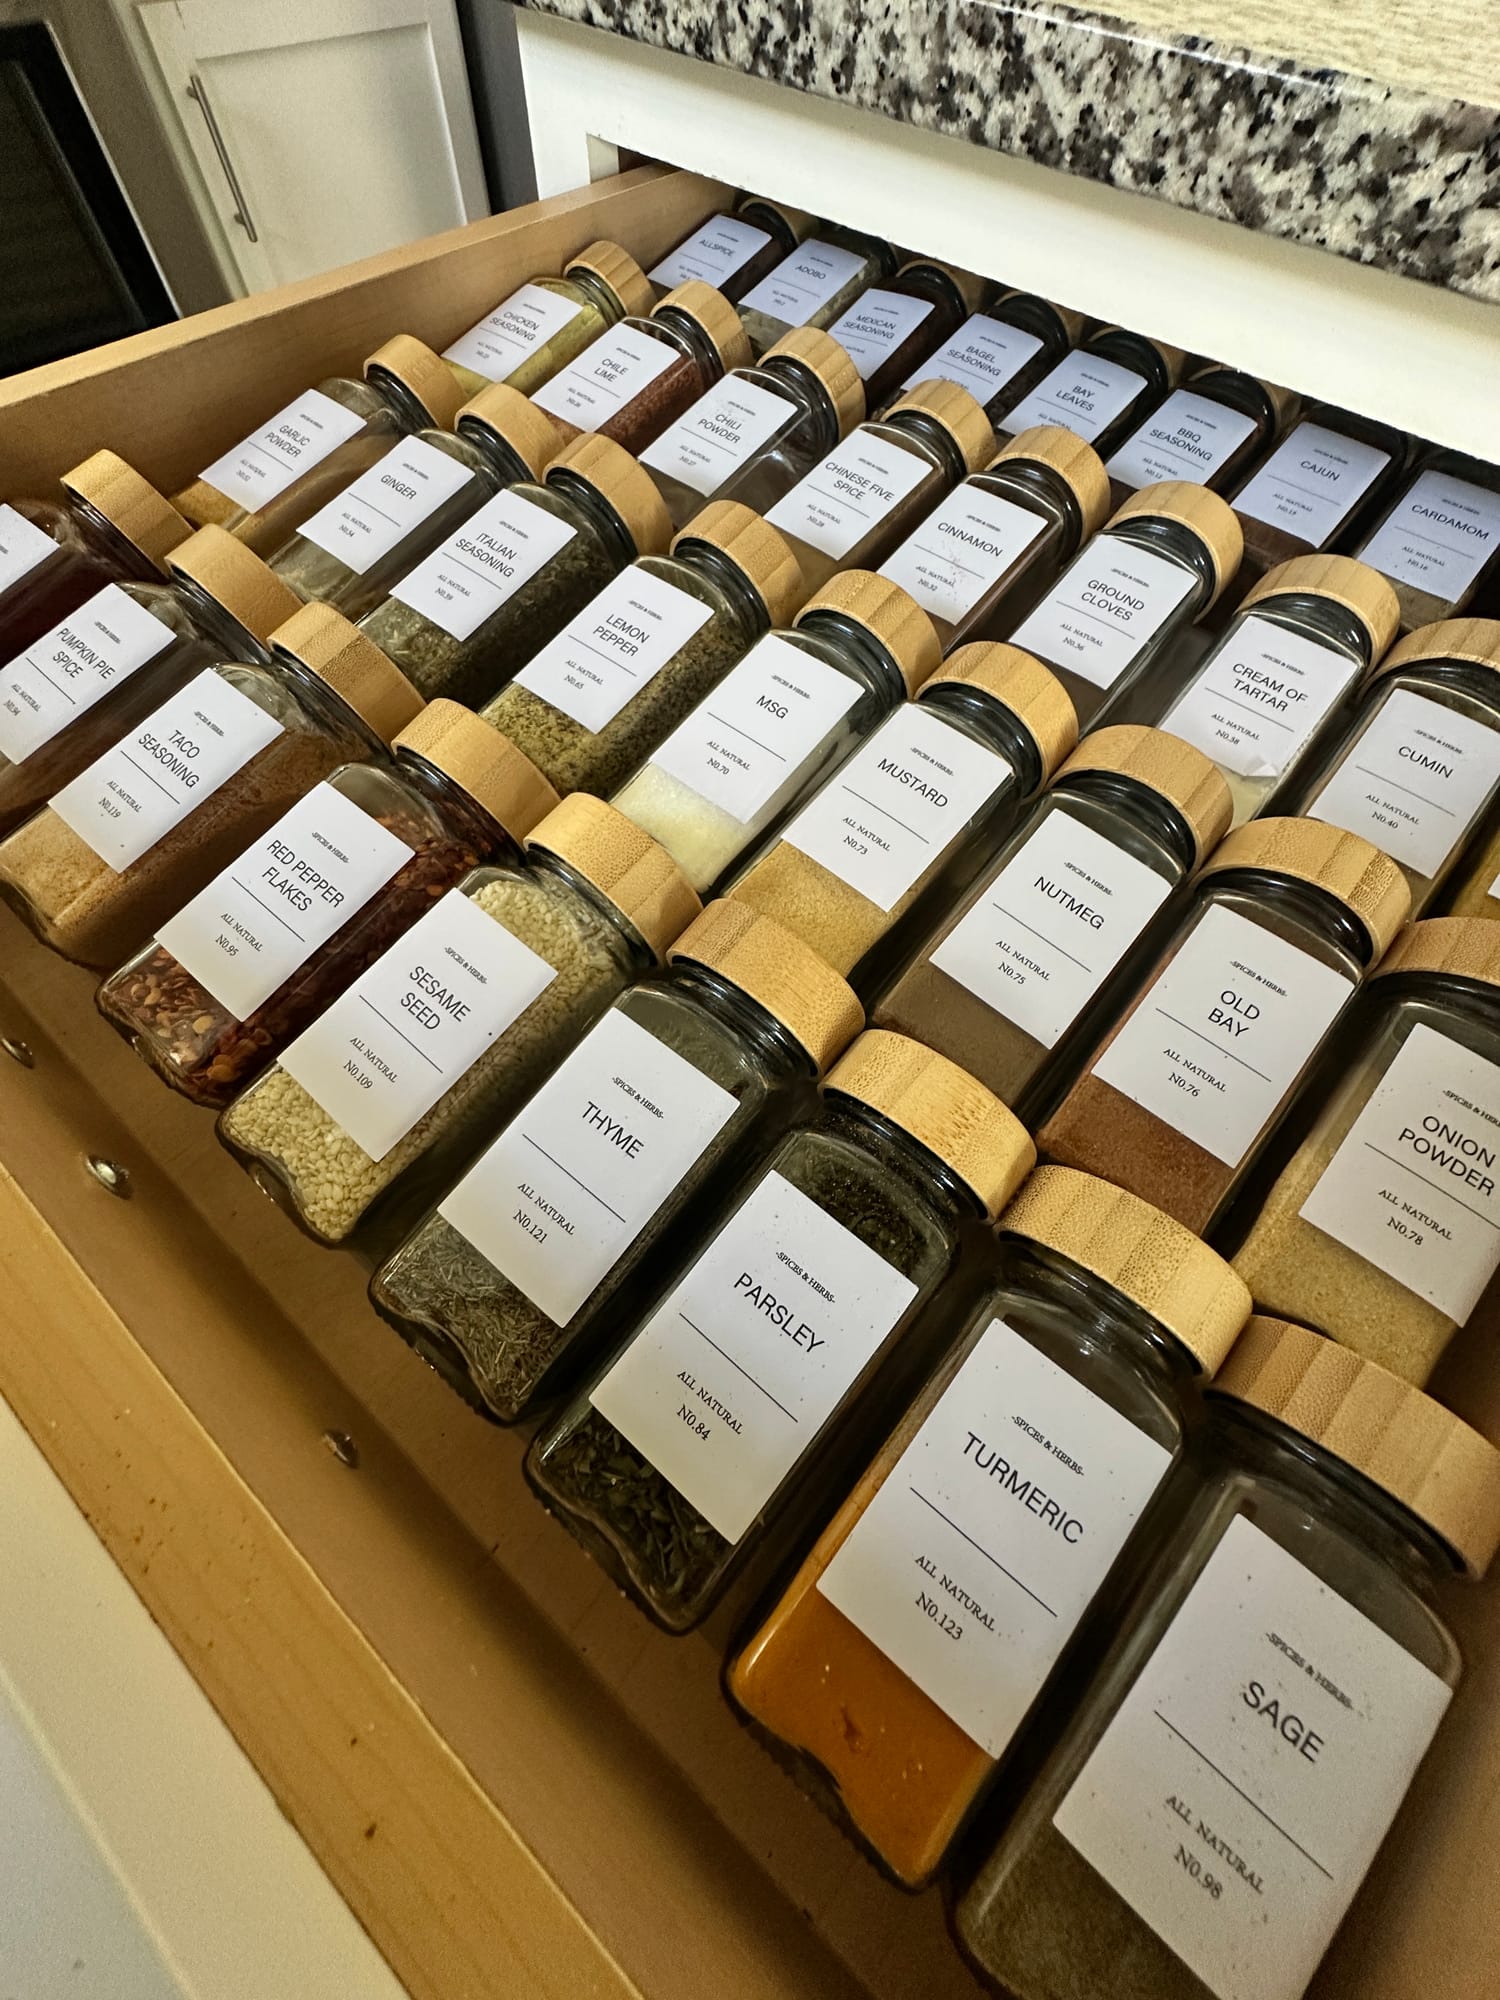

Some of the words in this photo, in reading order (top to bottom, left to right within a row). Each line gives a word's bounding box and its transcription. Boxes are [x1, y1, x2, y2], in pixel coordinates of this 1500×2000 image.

[699, 239, 736, 257] ALLSPICE
[795, 265, 827, 280] ADOBO
[489, 318, 536, 342] SEASONING
[503, 312, 539, 331] CHICKEN
[843, 322, 895, 340] SEASONING
[856, 315, 896, 330] MEXICAN
[601, 358, 629, 375] CHILE
[947, 349, 1001, 376] SEASONING
[966, 346, 996, 363] BAGEL
[594, 368, 617, 382] LIME
[1056, 390, 1095, 412] LEAVES
[1073, 385, 1095, 398] BAY
[279, 425, 310, 447] GARLIC
[698, 419, 741, 445] POWDER
[715, 414, 742, 430] CHILI
[1177, 428, 1201, 443] BBQ
[264, 432, 301, 458] POWDER
[1150, 429, 1213, 461] SEASONING
[825, 461, 869, 490] CHINESE
[869, 483, 894, 501] FIVE
[1301, 460, 1340, 481] CAJUN
[380, 474, 417, 500] GINGER
[833, 480, 866, 500] SPICE
[1411, 504, 1489, 540] CARDAMOM
[477, 532, 518, 560] ITALIAN
[938, 522, 1004, 557] CINNAMON
[455, 538, 515, 579] SEASONING
[1081, 592, 1133, 622] CLOVES
[1087, 579, 1145, 611] GROUND
[593, 626, 639, 657] PEPPER
[606, 614, 650, 644] LEMON
[52, 651, 85, 680] SPICE
[57, 627, 100, 666] PUMPKIN
[96, 659, 115, 680] PIE
[564, 659, 577, 669] ALL
[577, 664, 603, 685] NATURAL
[1232, 663, 1285, 695] CREAM
[1285, 687, 1308, 704] OF
[756, 694, 789, 720] MSG
[1233, 678, 1289, 712] TARTAR
[1211, 713, 1226, 724] ALL
[1225, 719, 1261, 741] NATURAL
[168, 729, 201, 759] TACO
[707, 741, 721, 751] ALL
[721, 746, 751, 770] NATURAL
[138, 734, 200, 788] SEASONING
[1398, 746, 1453, 779] CUMIN
[107, 780, 120, 792] ALL
[119, 788, 143, 813] NATURAL
[877, 758, 949, 808] MUSTARD
[1366, 794, 1382, 805] ALL
[1382, 801, 1420, 825] NATURAL
[842, 816, 858, 828] ALL
[857, 823, 891, 851] NATURAL
[266, 839, 296, 865] RED
[291, 860, 344, 908] PEPPER
[262, 867, 312, 912] FLAKES
[1034, 876, 1105, 930] NUTMEG
[221, 912, 233, 925] ALL
[233, 923, 264, 952] NATURAL
[996, 939, 1011, 953] ALL
[1013, 951, 1050, 981] NATURAL
[410, 966, 471, 1023] SESAME
[1220, 990, 1261, 1020] OLD
[400, 992, 441, 1031] SEED
[1208, 1007, 1250, 1037] BAY
[350, 1036, 365, 1052] ALL
[364, 1049, 399, 1084] NATURAL
[1163, 1048, 1181, 1063] ALL
[1182, 1059, 1227, 1092] NATURAL
[1472, 1106, 1480, 1114] &
[582, 1101, 644, 1160] THYME
[1422, 1115, 1497, 1168] ONION
[1398, 1128, 1495, 1197] POWDER
[518, 1183, 534, 1199] ALL
[534, 1196, 576, 1235] NATURAL
[1378, 1189, 1398, 1205] ALL
[1401, 1201, 1453, 1241] NATURAL
[801, 1272, 810, 1281] &
[734, 1272, 825, 1354] PARSLEY
[677, 1369, 696, 1390] ALL
[696, 1387, 743, 1435] NATURAL
[1044, 1439, 1052, 1449] &
[963, 1431, 1085, 1545] TURMERIC
[915, 1554, 937, 1578] ALL
[939, 1574, 996, 1631] NATURAL
[1305, 1664, 1314, 1675] &
[1242, 1680, 1325, 1763] SAGE
[1166, 1794, 1192, 1824] ALL
[1197, 1821, 1265, 1894] NATURAL
